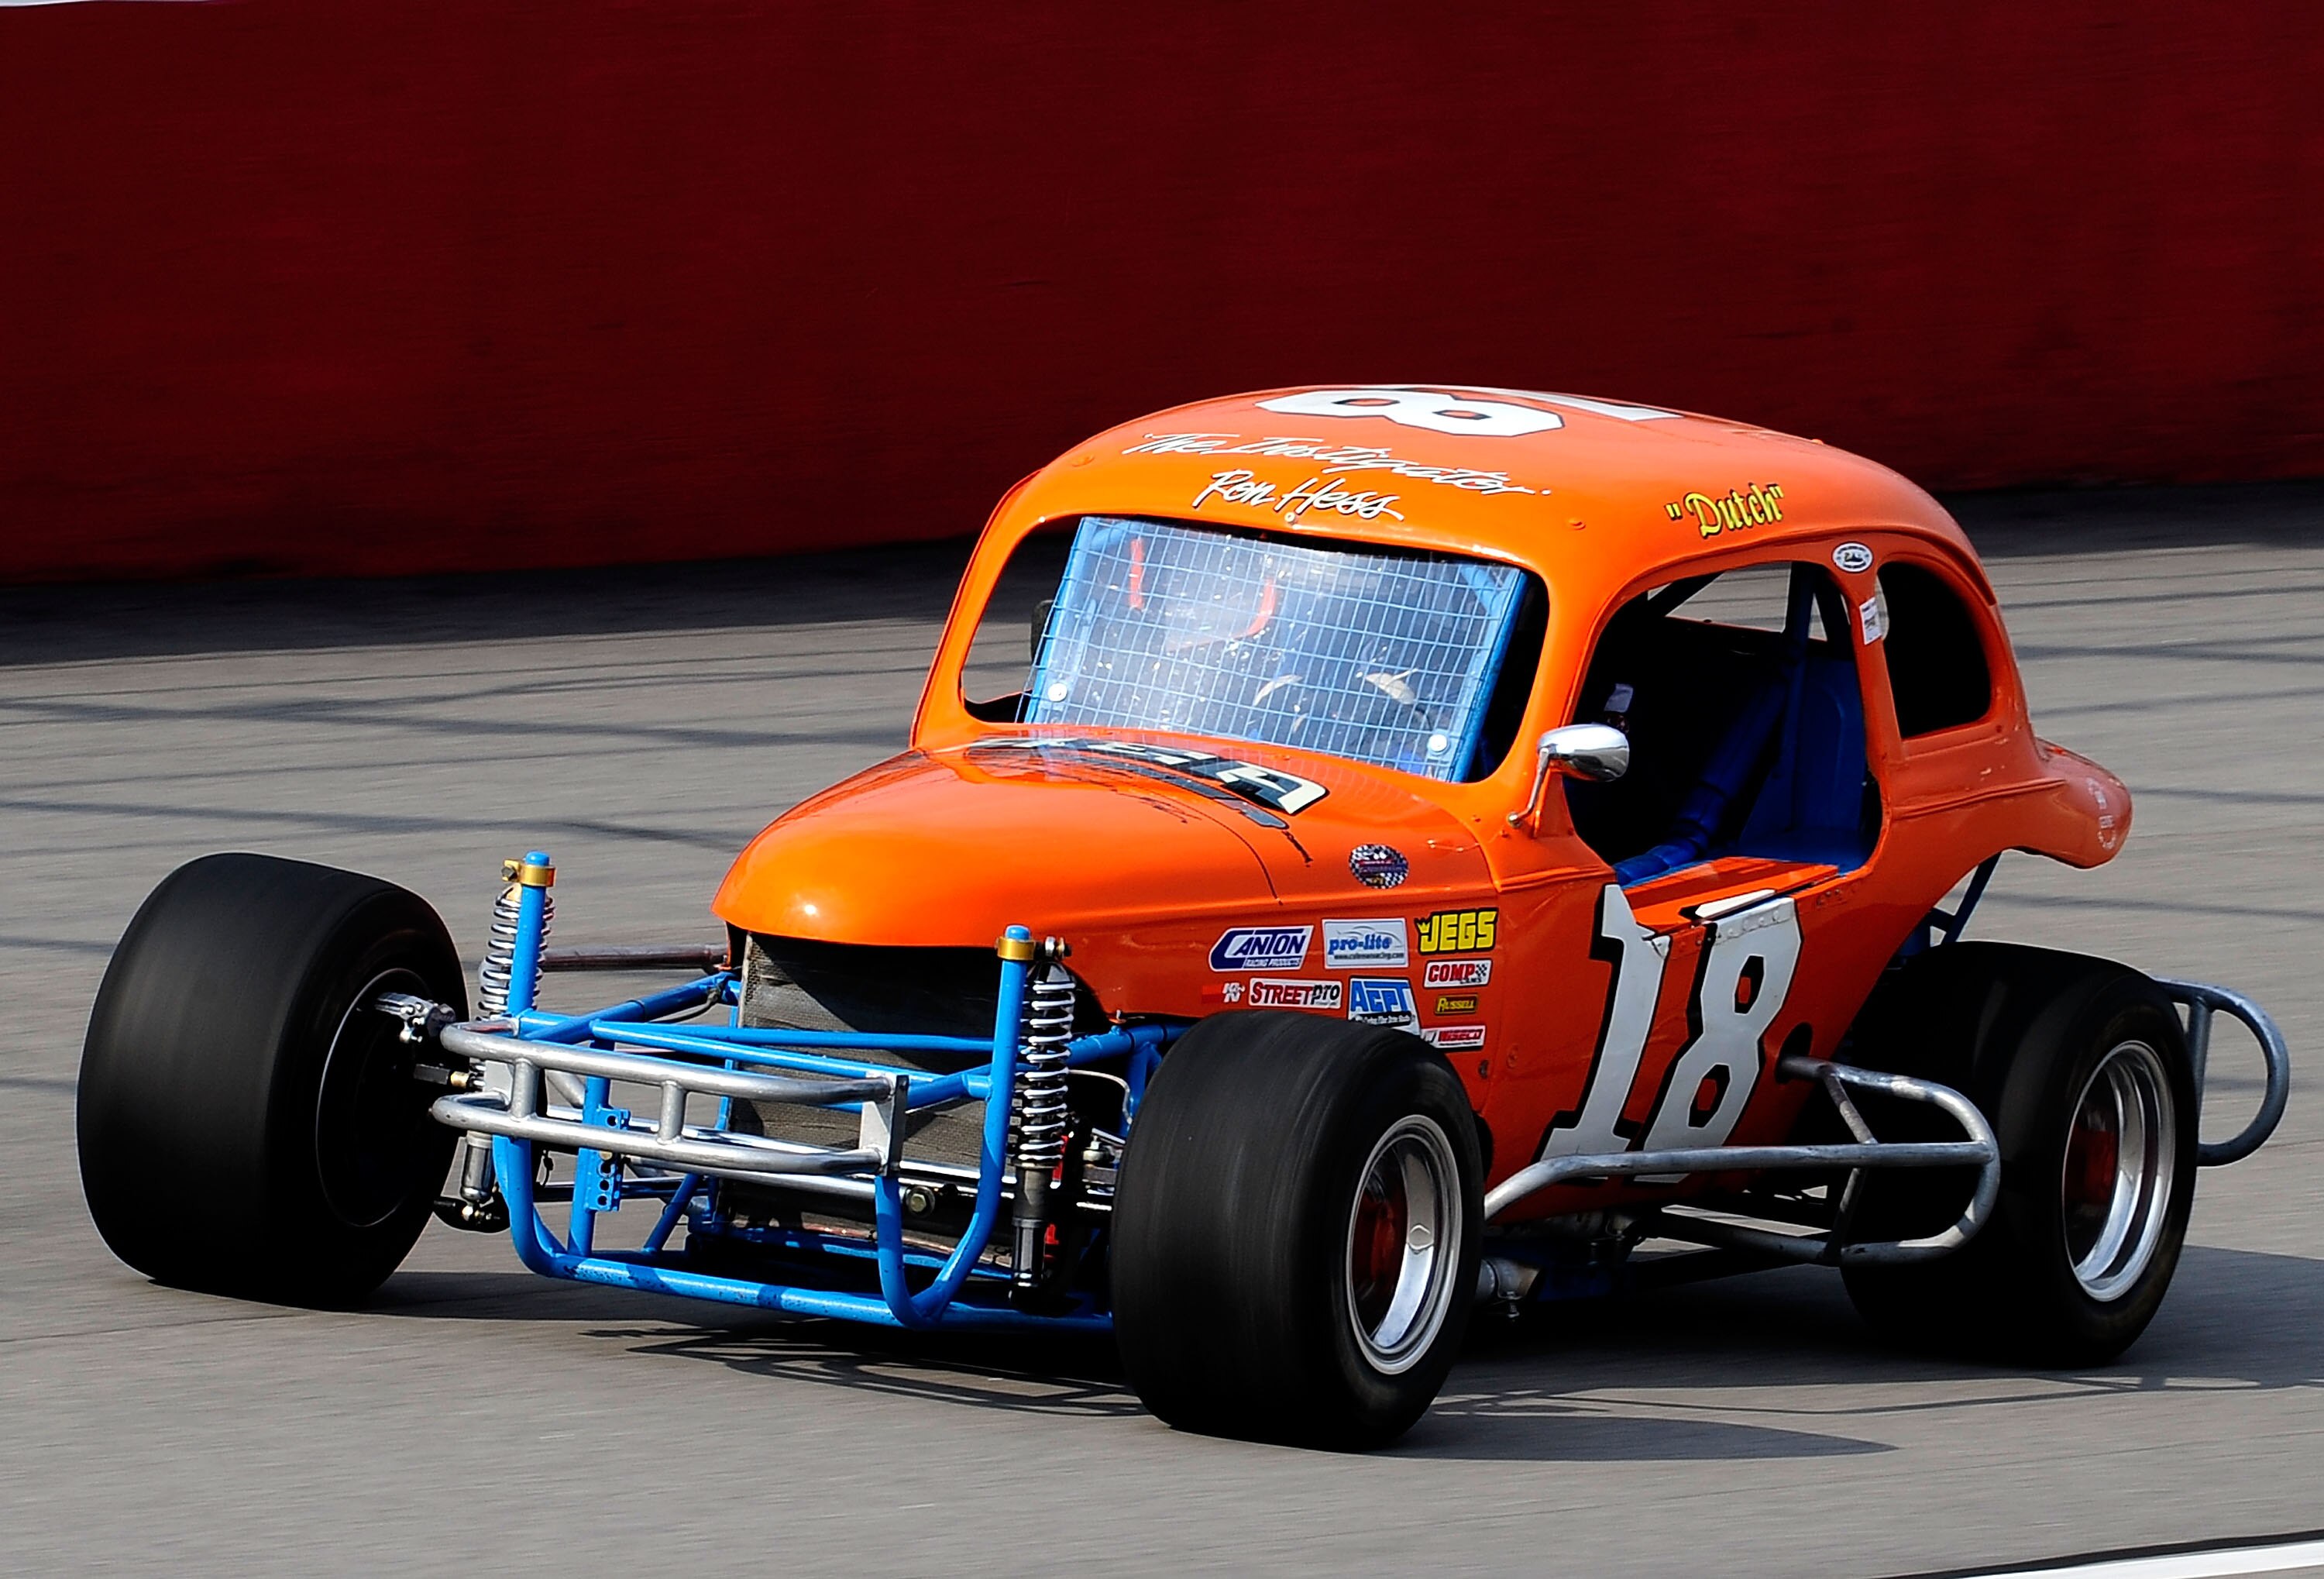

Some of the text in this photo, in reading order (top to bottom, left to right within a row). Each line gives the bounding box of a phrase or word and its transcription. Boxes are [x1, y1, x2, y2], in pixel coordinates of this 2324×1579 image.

[1122, 433, 1241, 455] The
[1191, 469, 1404, 521] Ron Hess
[1210, 928, 1306, 969] CANTON
[1328, 934, 1393, 955] pro-lite
[1420, 911, 1497, 952] JEGS
[1428, 963, 1476, 982] COMP
[1539, 884, 1803, 1182] 18
